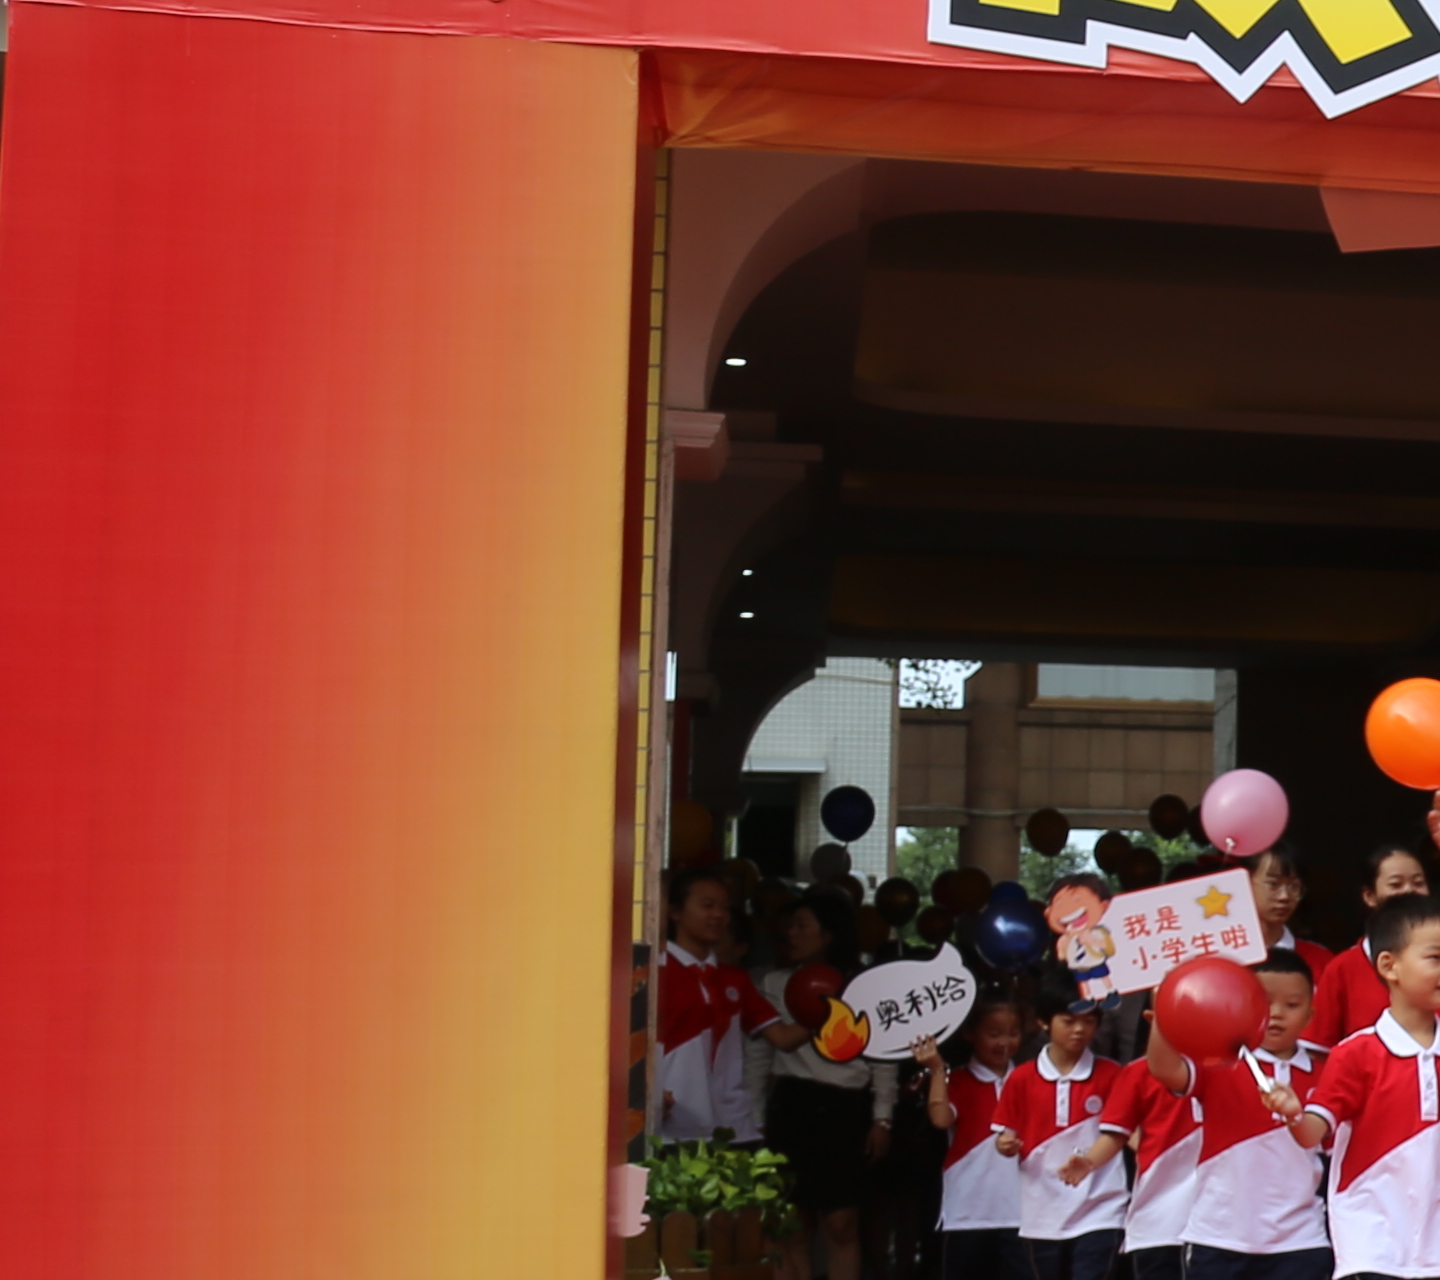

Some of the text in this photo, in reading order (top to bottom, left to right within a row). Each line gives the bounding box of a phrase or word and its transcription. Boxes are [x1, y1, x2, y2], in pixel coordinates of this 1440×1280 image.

[1123, 905, 1182, 940] 我是
[1131, 925, 1250, 970] 小学生啦
[876, 975, 967, 1033] 奥利给
